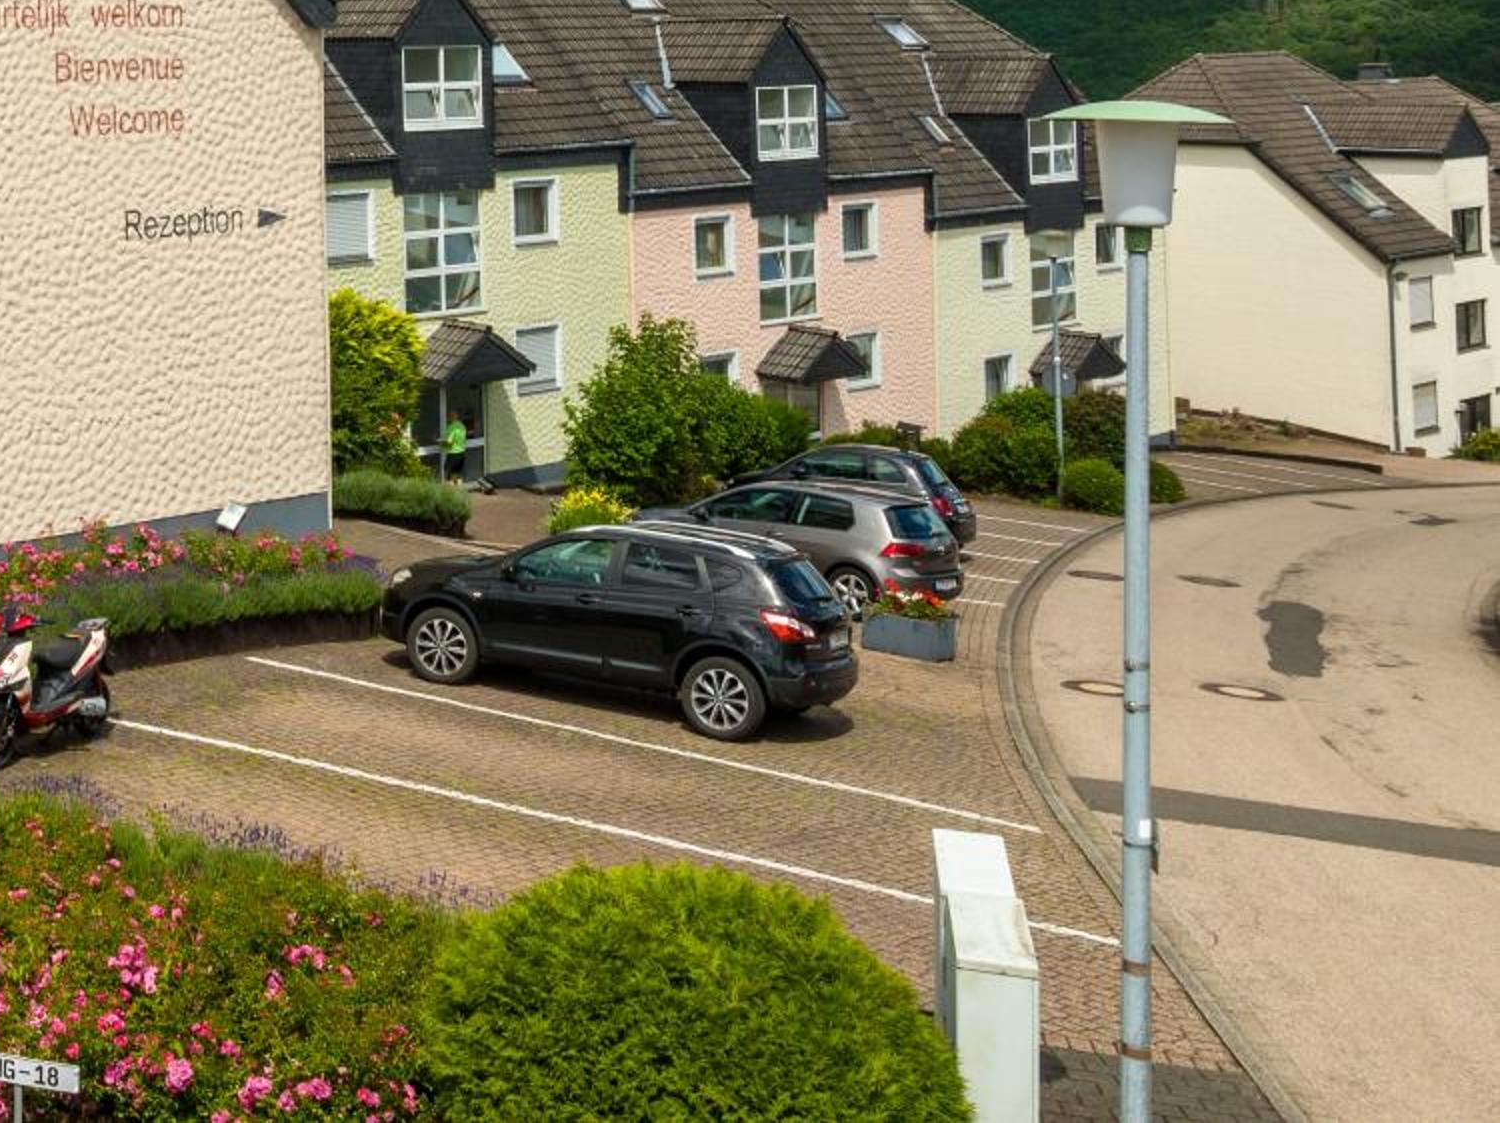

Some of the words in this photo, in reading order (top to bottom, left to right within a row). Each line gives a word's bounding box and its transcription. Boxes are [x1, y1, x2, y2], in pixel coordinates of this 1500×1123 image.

[54, 51, 185, 84] Bienvenue
[69, 104, 186, 136] Welcome
[124, 206, 244, 242] Rezeption
